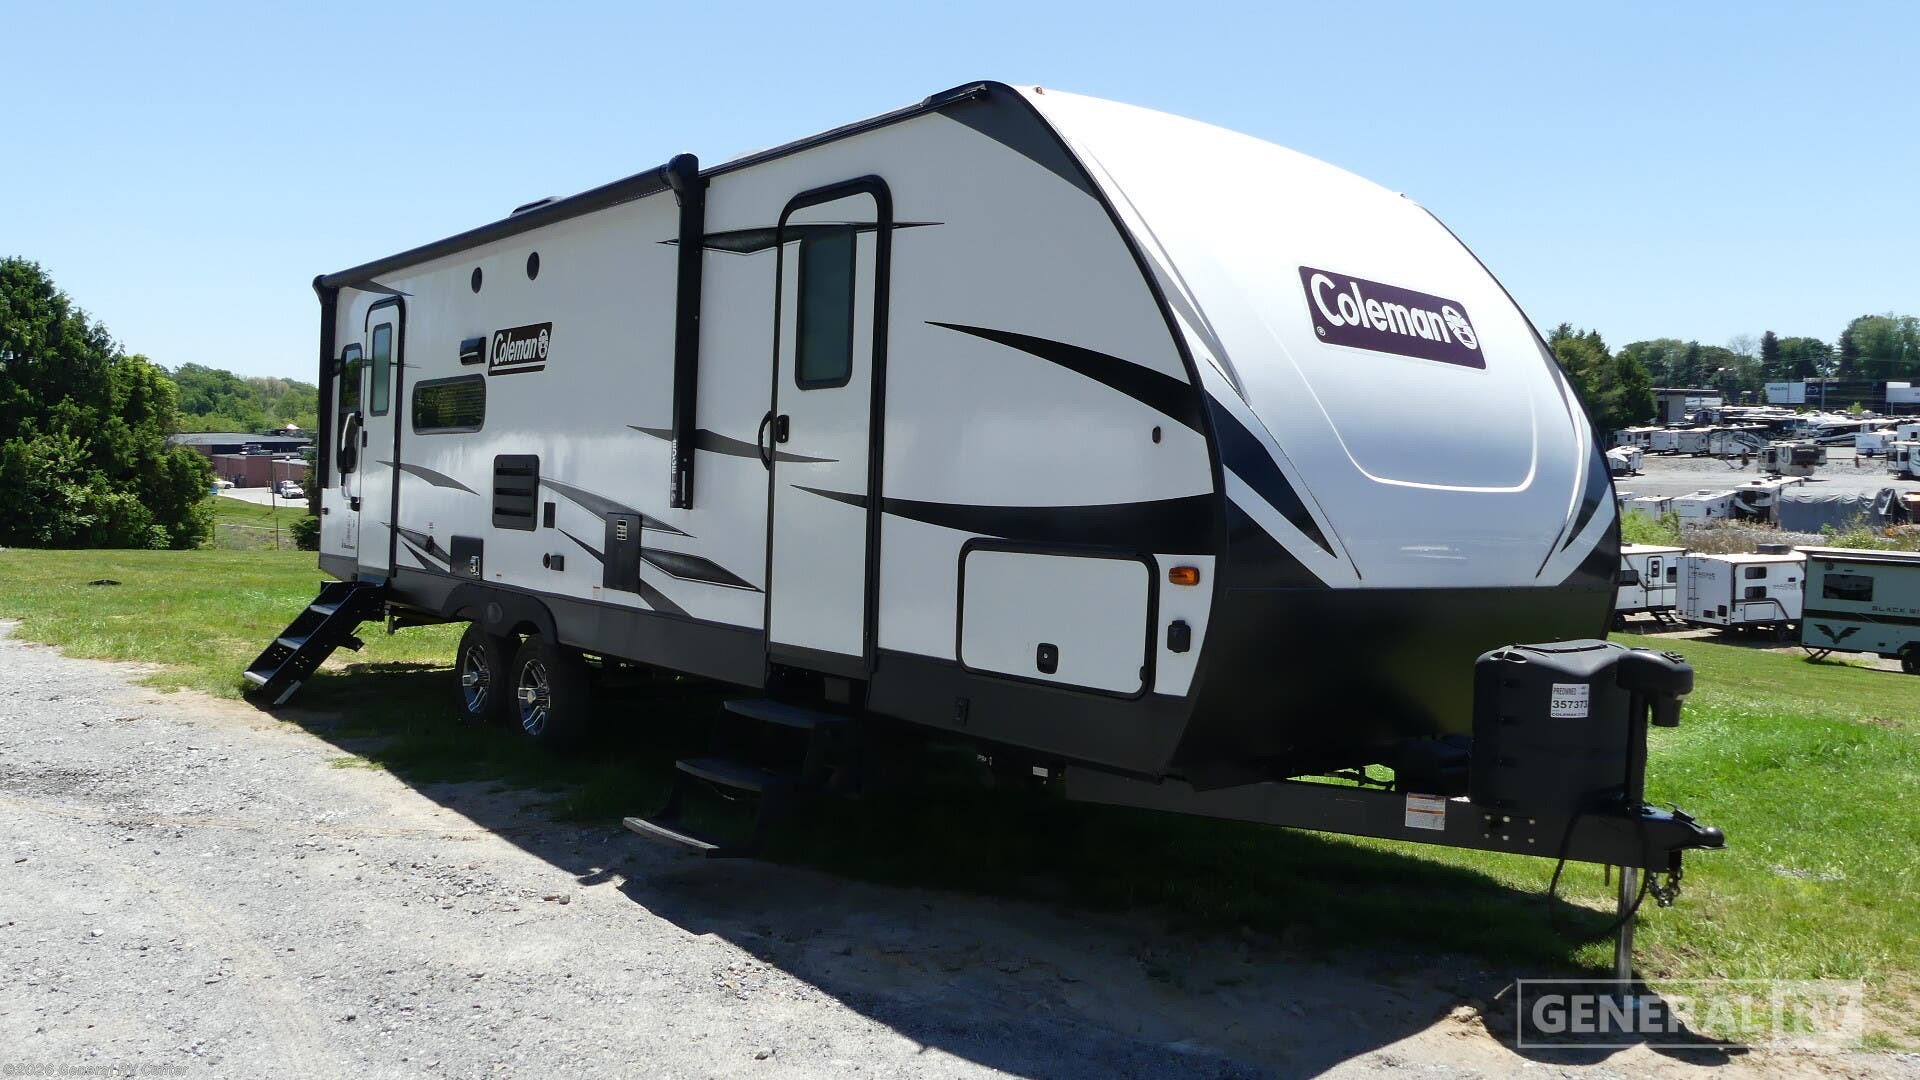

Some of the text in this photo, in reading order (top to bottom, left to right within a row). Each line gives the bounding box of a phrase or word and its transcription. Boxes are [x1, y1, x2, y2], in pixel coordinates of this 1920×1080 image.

[1310, 273, 1451, 343] Coleman
[493, 332, 538, 365] Coleman
[1552, 700, 1588, 709] 357373
